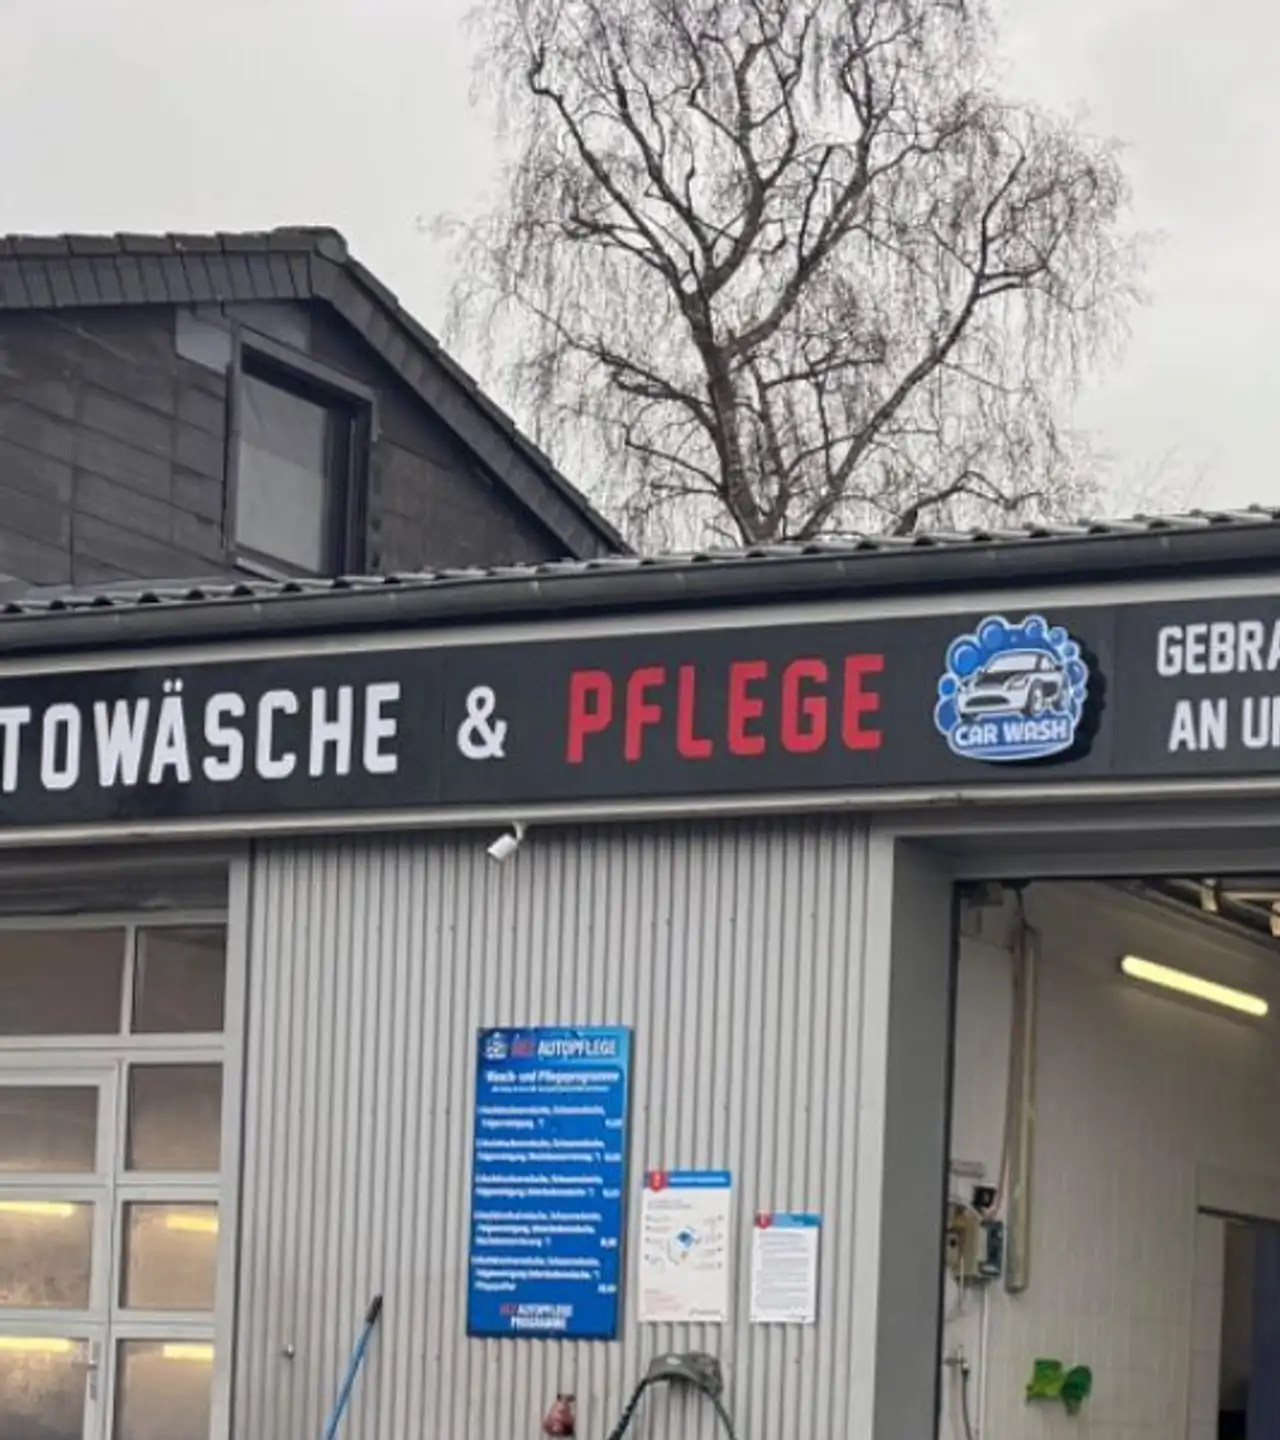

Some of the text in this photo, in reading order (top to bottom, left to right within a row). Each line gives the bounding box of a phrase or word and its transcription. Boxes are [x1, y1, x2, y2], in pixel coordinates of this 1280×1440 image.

[0, 654, 886, 792] TOWÄSCHE & PFLEGE
[955, 718, 1067, 746] CAR WASH
[1167, 698, 1229, 752] AN
